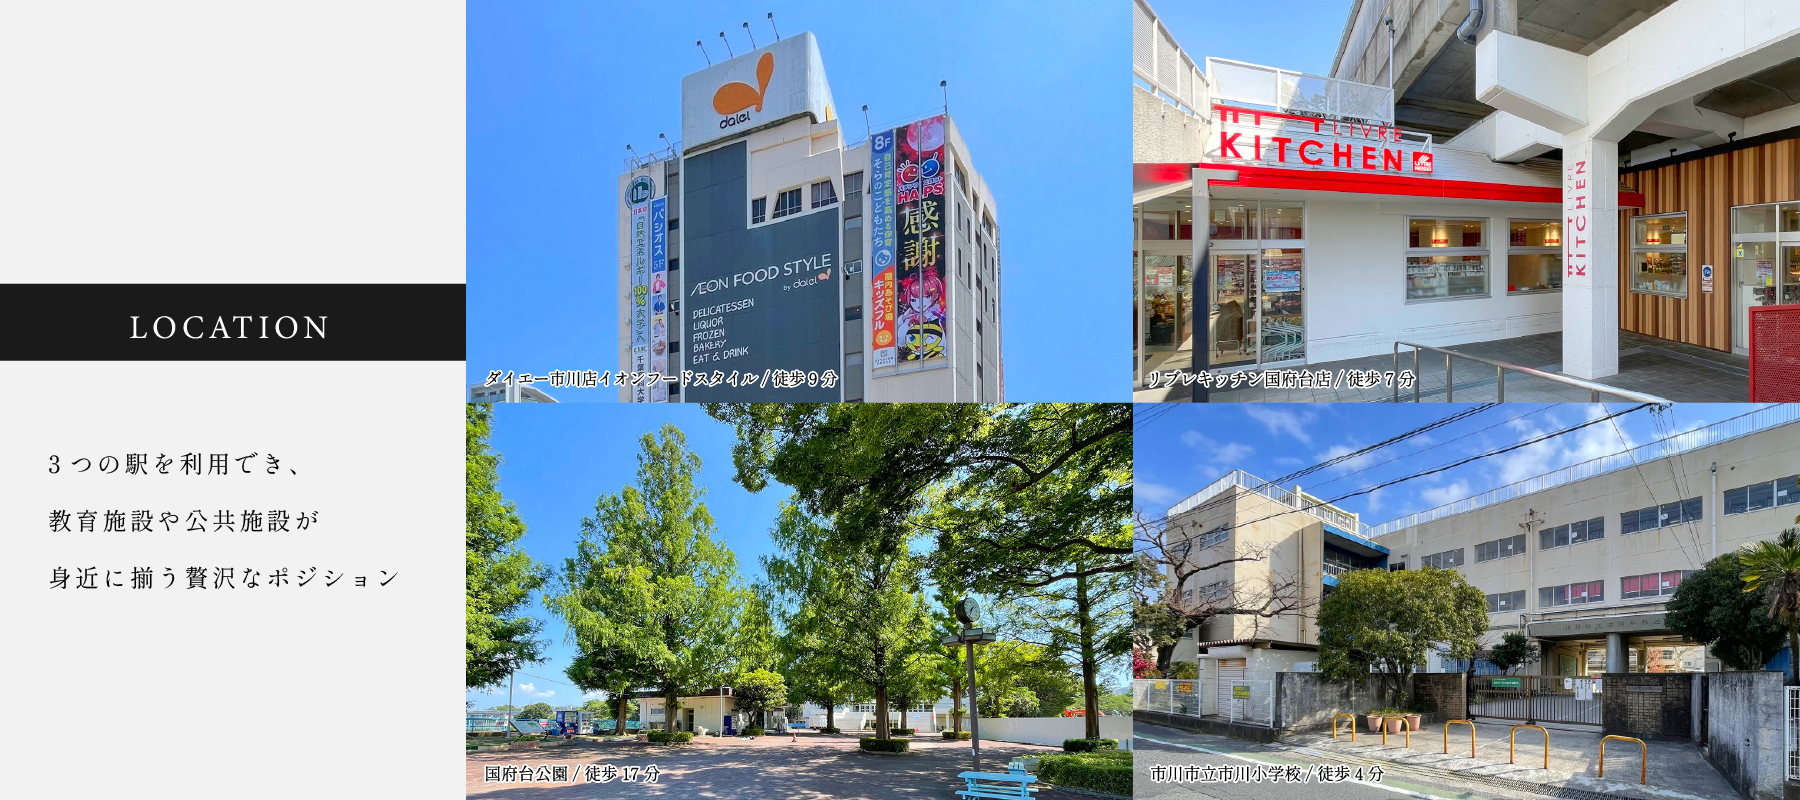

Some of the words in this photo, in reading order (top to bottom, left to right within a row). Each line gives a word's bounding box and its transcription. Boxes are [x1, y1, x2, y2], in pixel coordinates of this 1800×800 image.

[1333, 120, 1402, 143] LIVRE
[874, 136, 891, 151] 8F
[1221, 131, 1402, 172] KITCHEN
[873, 158, 884, 248] そらのこどもたち
[897, 182, 944, 205] HAPS
[1575, 160, 1587, 277] KITCHEN
[653, 208, 665, 257] パシオス
[902, 201, 941, 272] 感謝
[653, 259, 665, 270] 5F
[733, 265, 780, 288] FOOD
[783, 253, 832, 276] STYLE
[692, 298, 755, 319] DELICATESSEN
[692, 316, 724, 331] LIQUOR
[692, 328, 725, 343] FROZEN
[692, 340, 727, 353] BAKERY
[692, 353, 710, 365] EAT
[712, 351, 721, 362] &
[723, 346, 749, 360] DRINK
